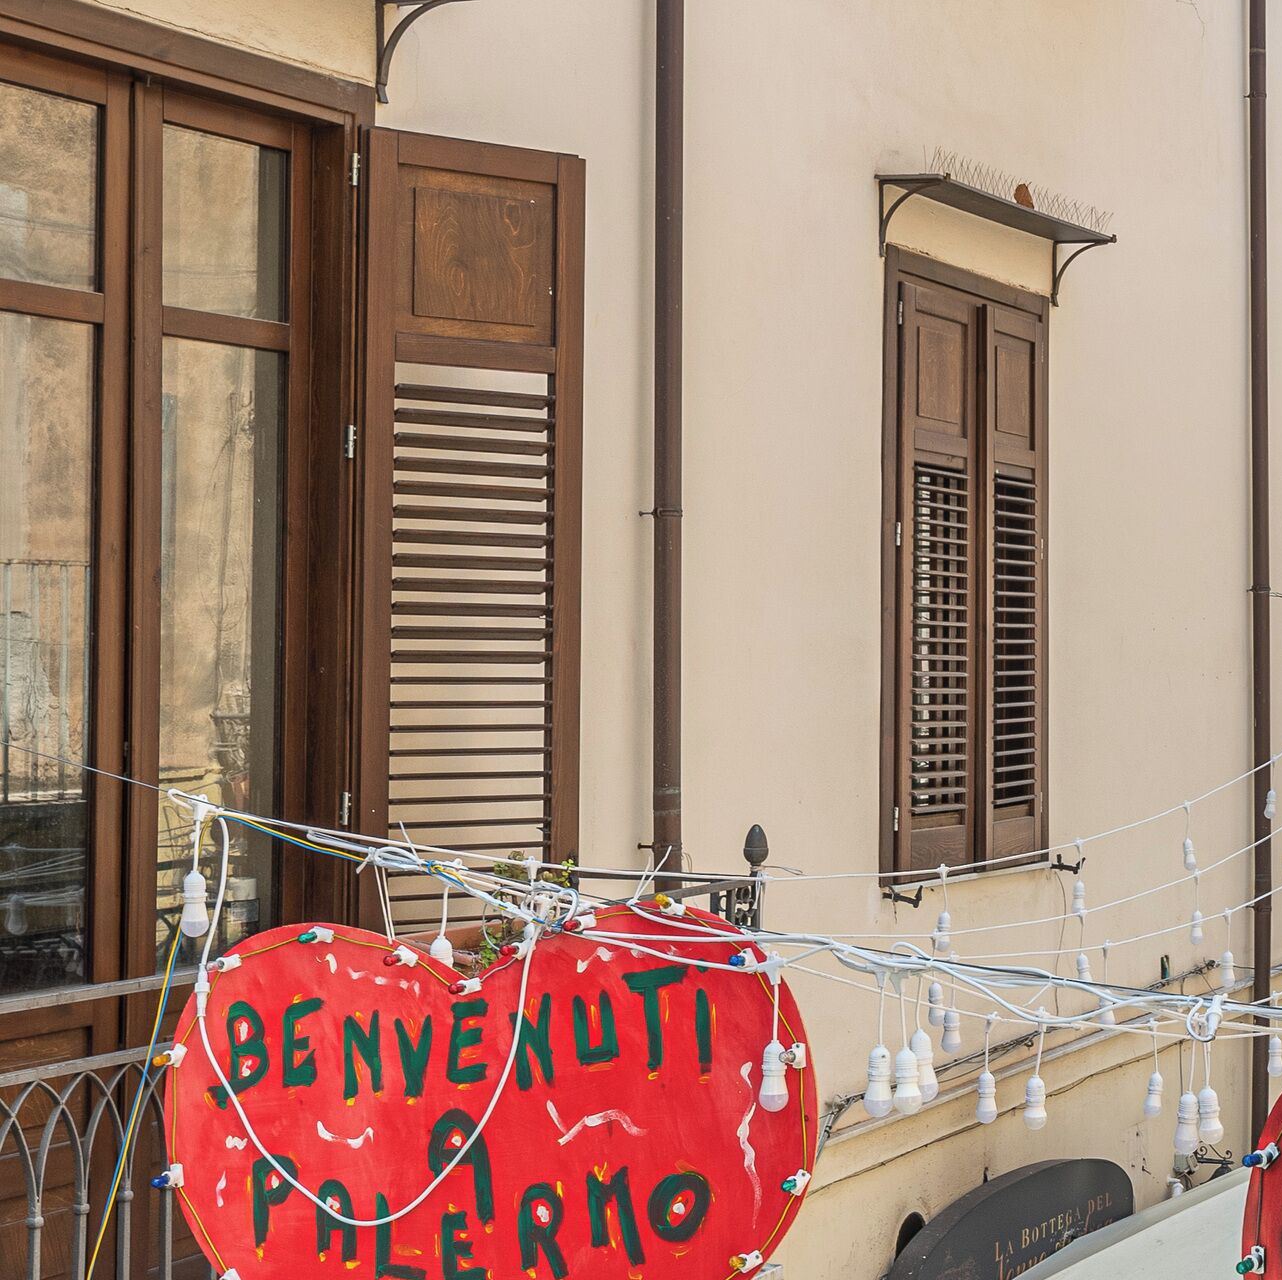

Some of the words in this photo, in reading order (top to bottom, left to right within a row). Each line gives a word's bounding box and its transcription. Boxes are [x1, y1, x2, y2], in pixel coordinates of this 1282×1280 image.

[206, 964, 712, 1110] BENVENUTI
[428, 1108, 496, 1223] A
[995, 1240, 1014, 1262] LA
[1021, 1207, 1081, 1249] BOTTEGA
[1088, 1192, 1113, 1216] DEL
